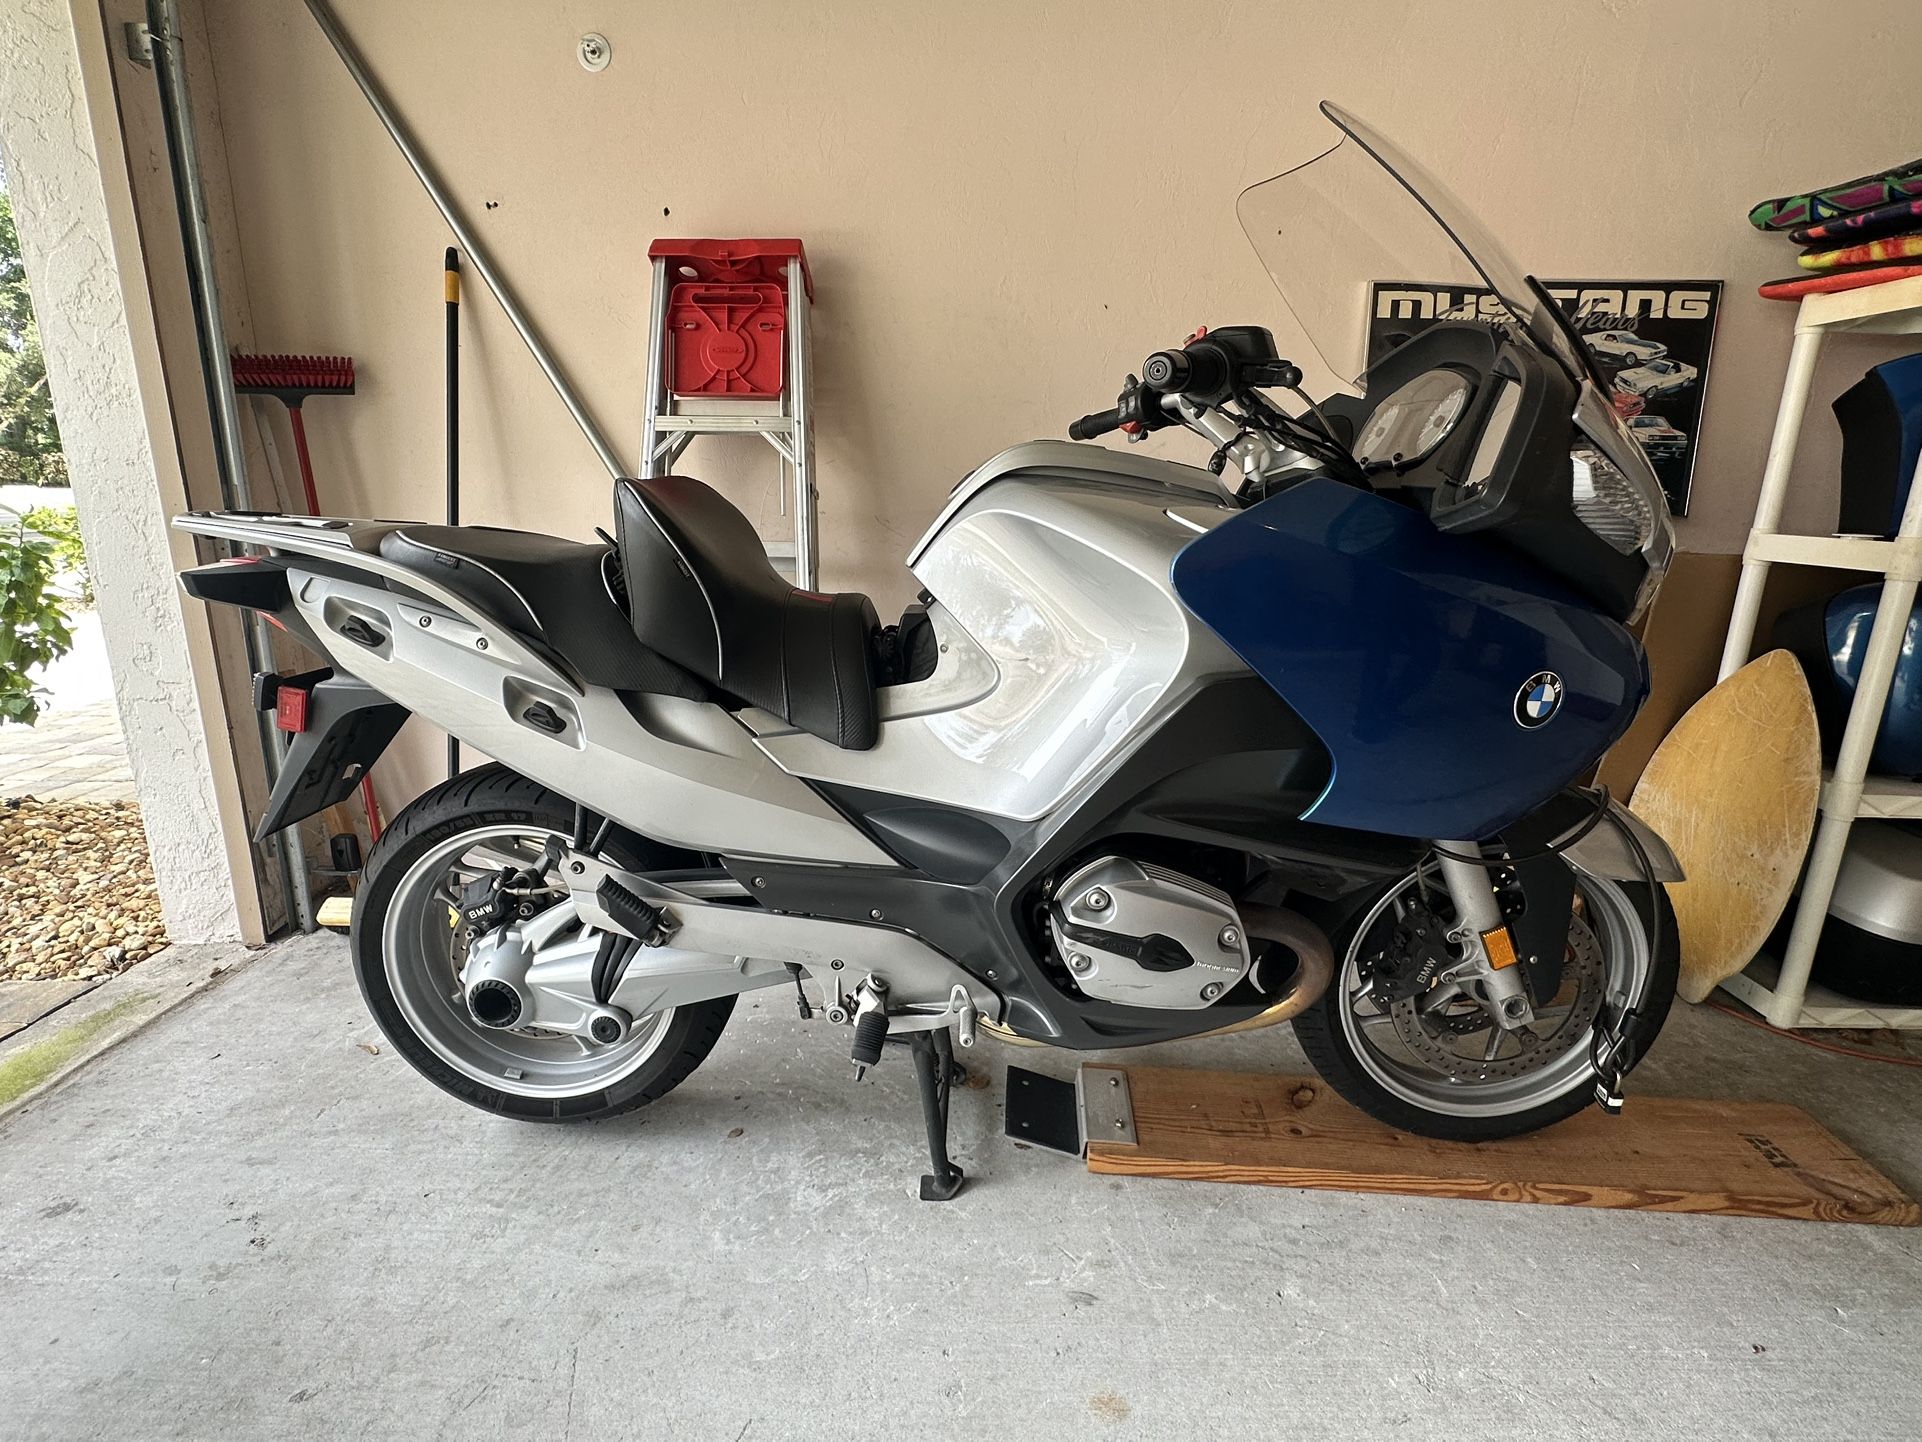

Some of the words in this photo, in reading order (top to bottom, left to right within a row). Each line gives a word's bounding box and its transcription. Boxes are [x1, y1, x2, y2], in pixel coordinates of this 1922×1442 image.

[1525, 674, 1562, 692] BMW
[468, 903, 493, 920] BMW
[1416, 956, 1437, 984] BMW
